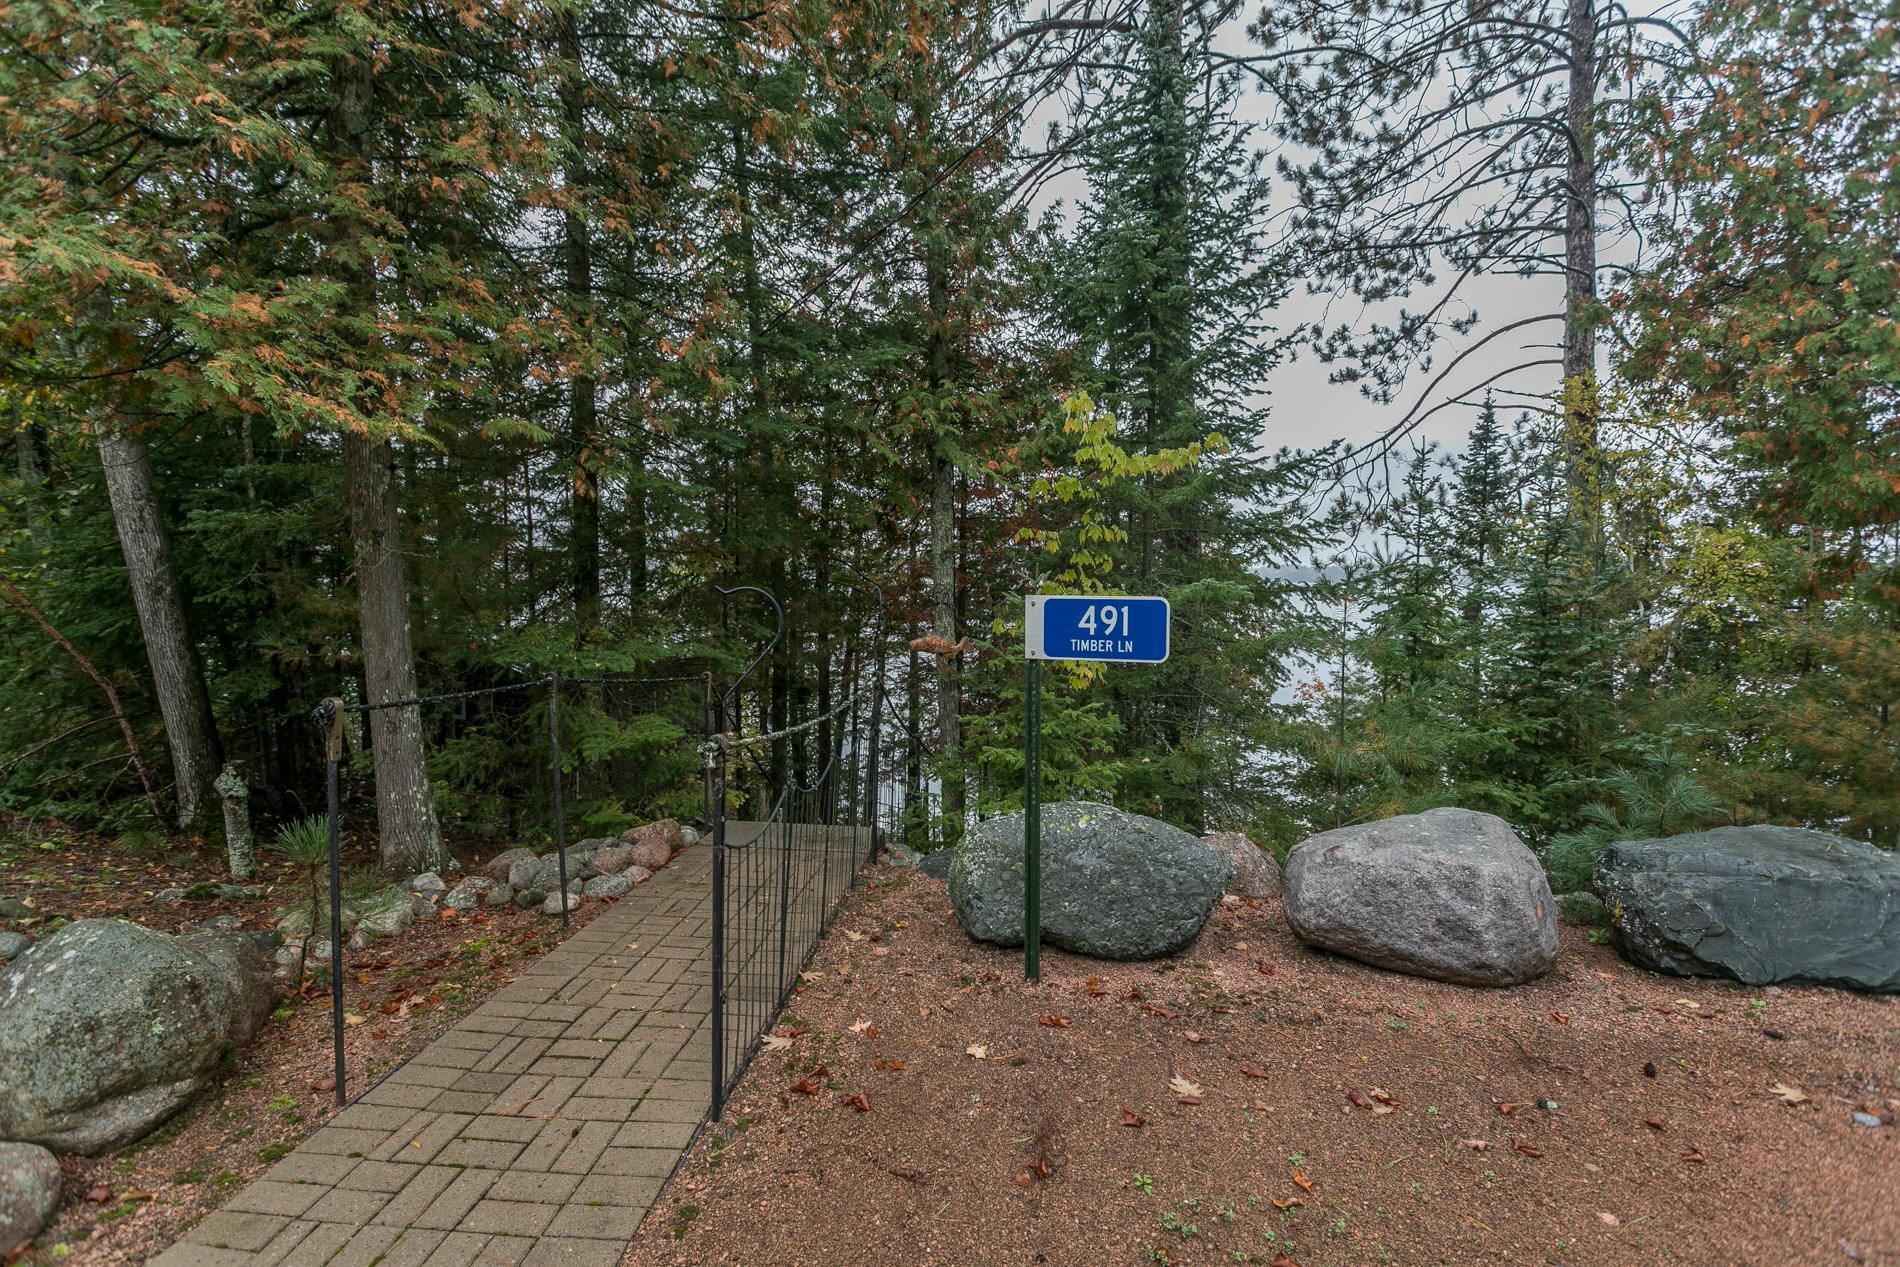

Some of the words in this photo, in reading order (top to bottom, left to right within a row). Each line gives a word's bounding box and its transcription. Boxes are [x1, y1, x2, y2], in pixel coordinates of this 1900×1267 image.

[1078, 605, 1129, 636] 491
[1070, 639, 1113, 652] TIMBER
[1117, 640, 1133, 653] LN
